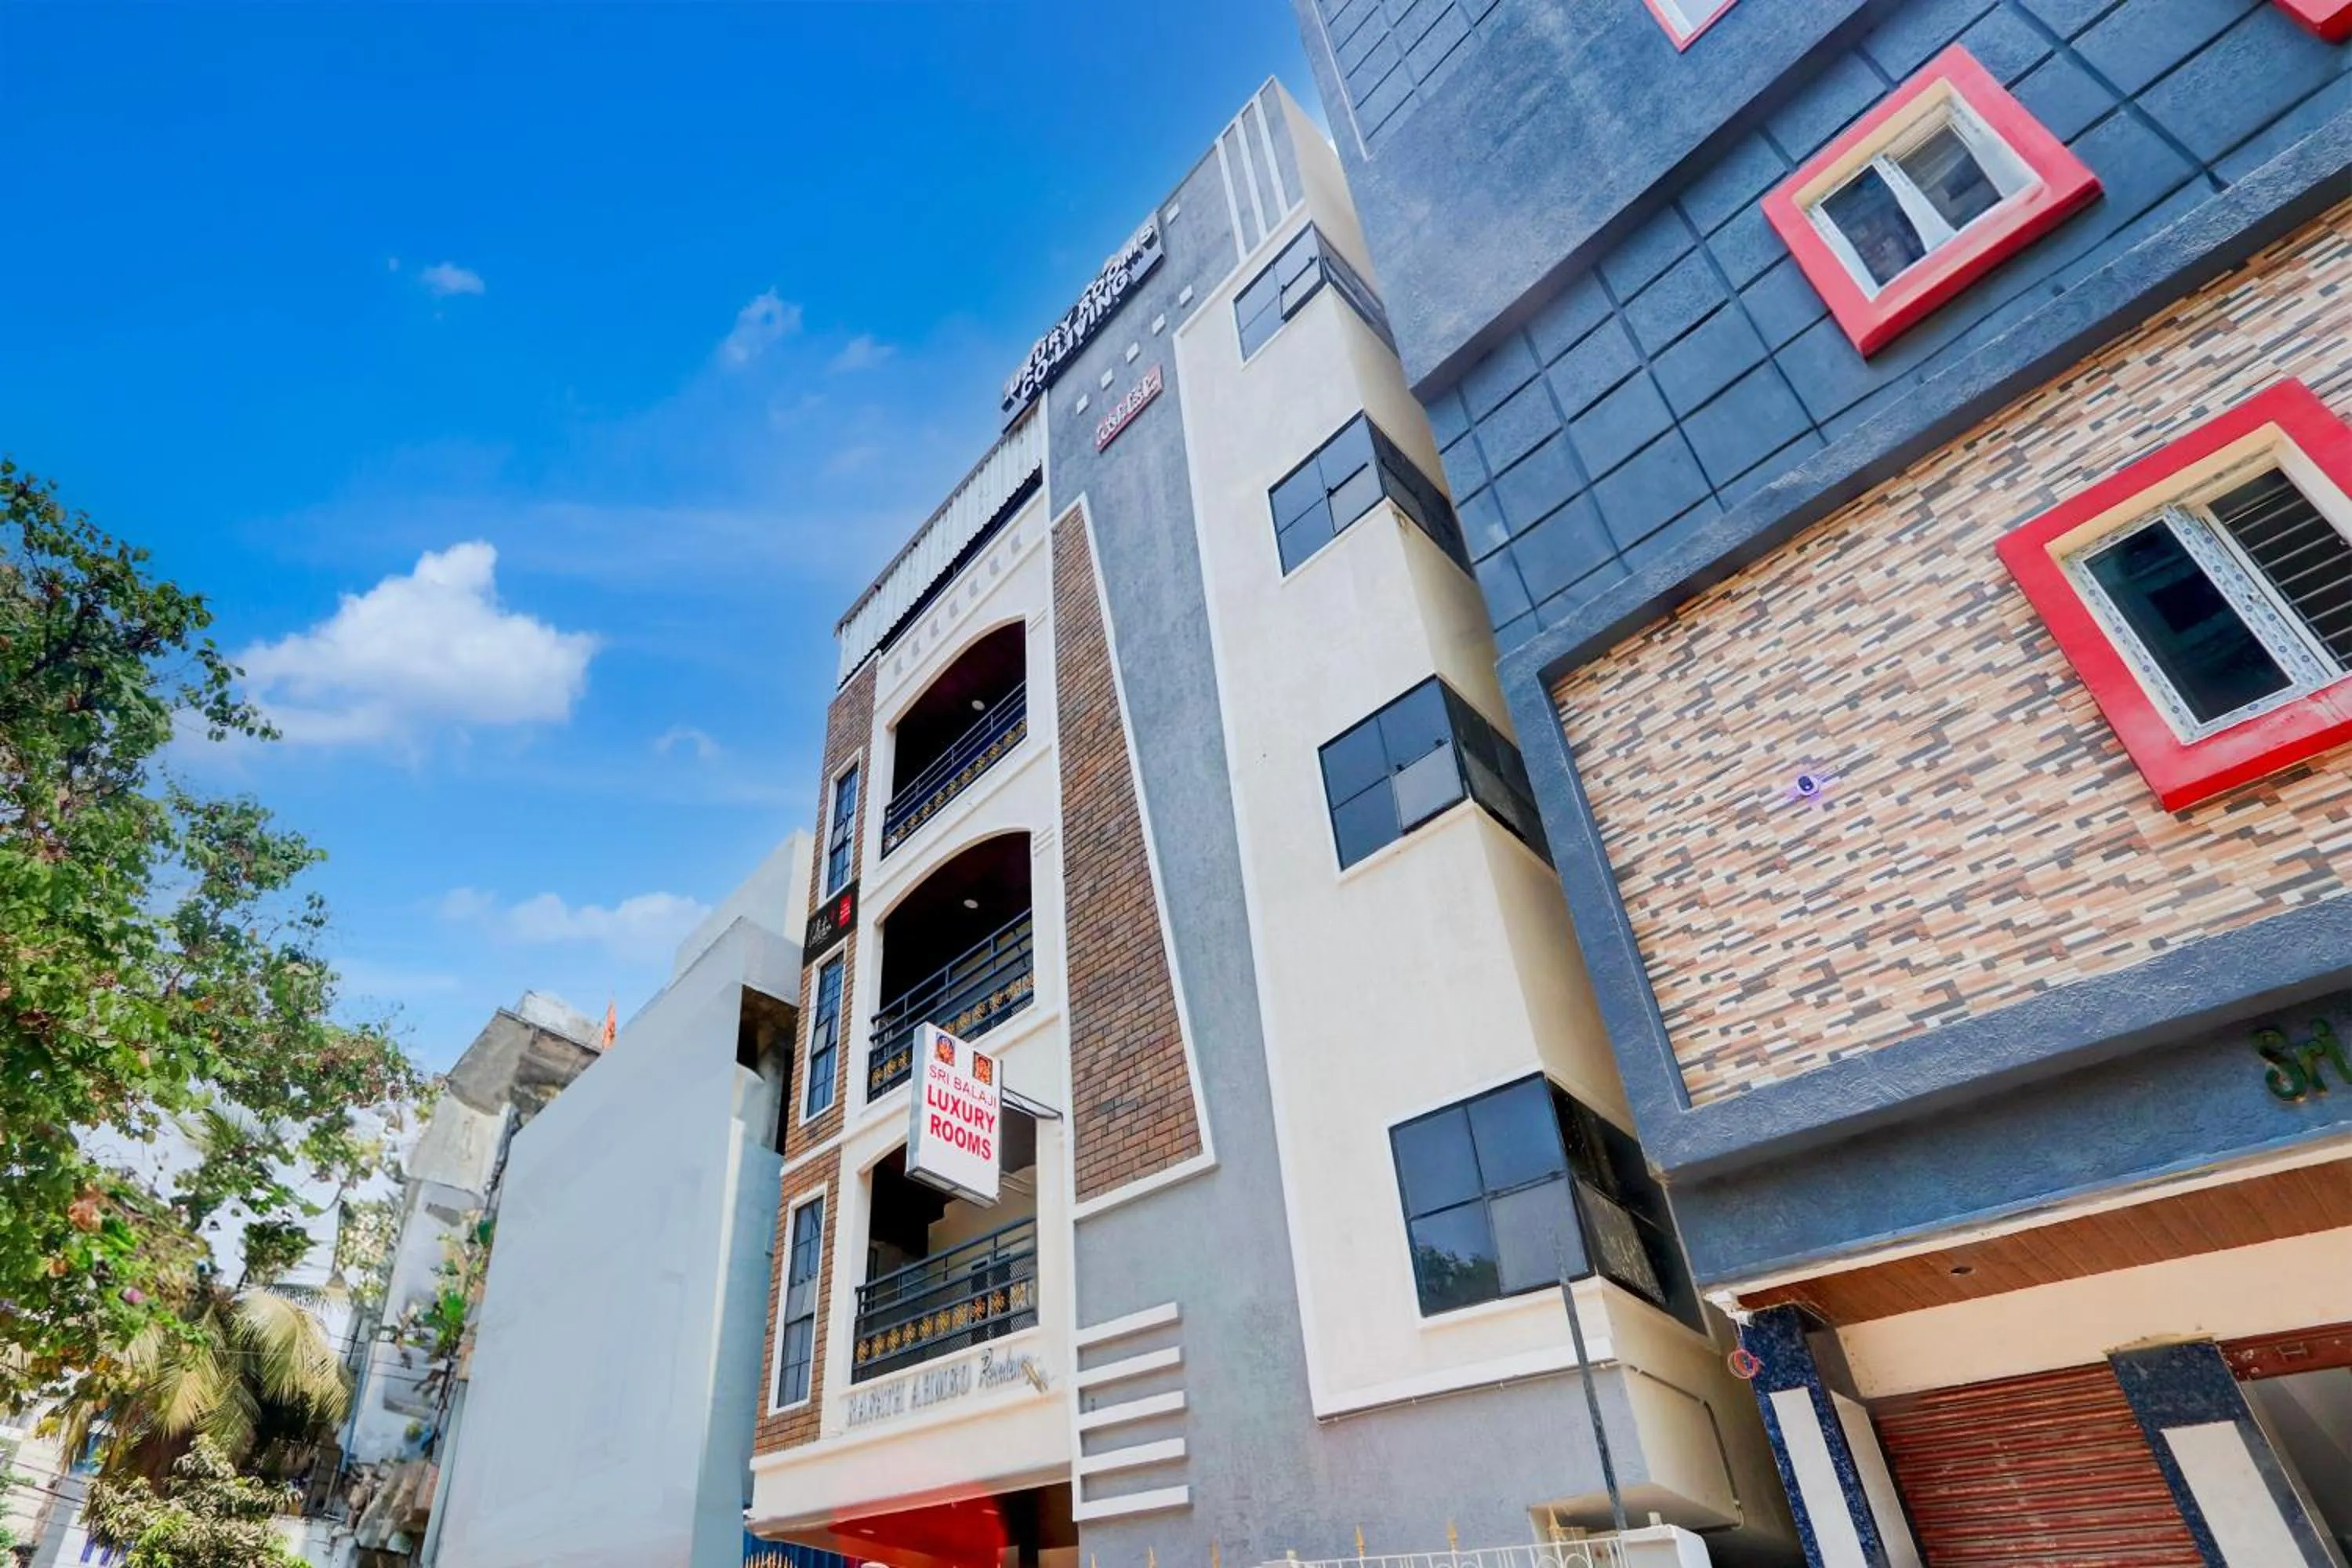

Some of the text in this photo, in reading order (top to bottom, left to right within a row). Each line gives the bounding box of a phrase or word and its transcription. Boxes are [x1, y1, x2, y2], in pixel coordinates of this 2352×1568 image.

[1021, 270, 1129, 400] CO-LIVING
[927, 1084, 996, 1134] LUXURY
[928, 1064, 997, 1109] SRI BALAJI
[930, 1114, 992, 1161] ROOMS
